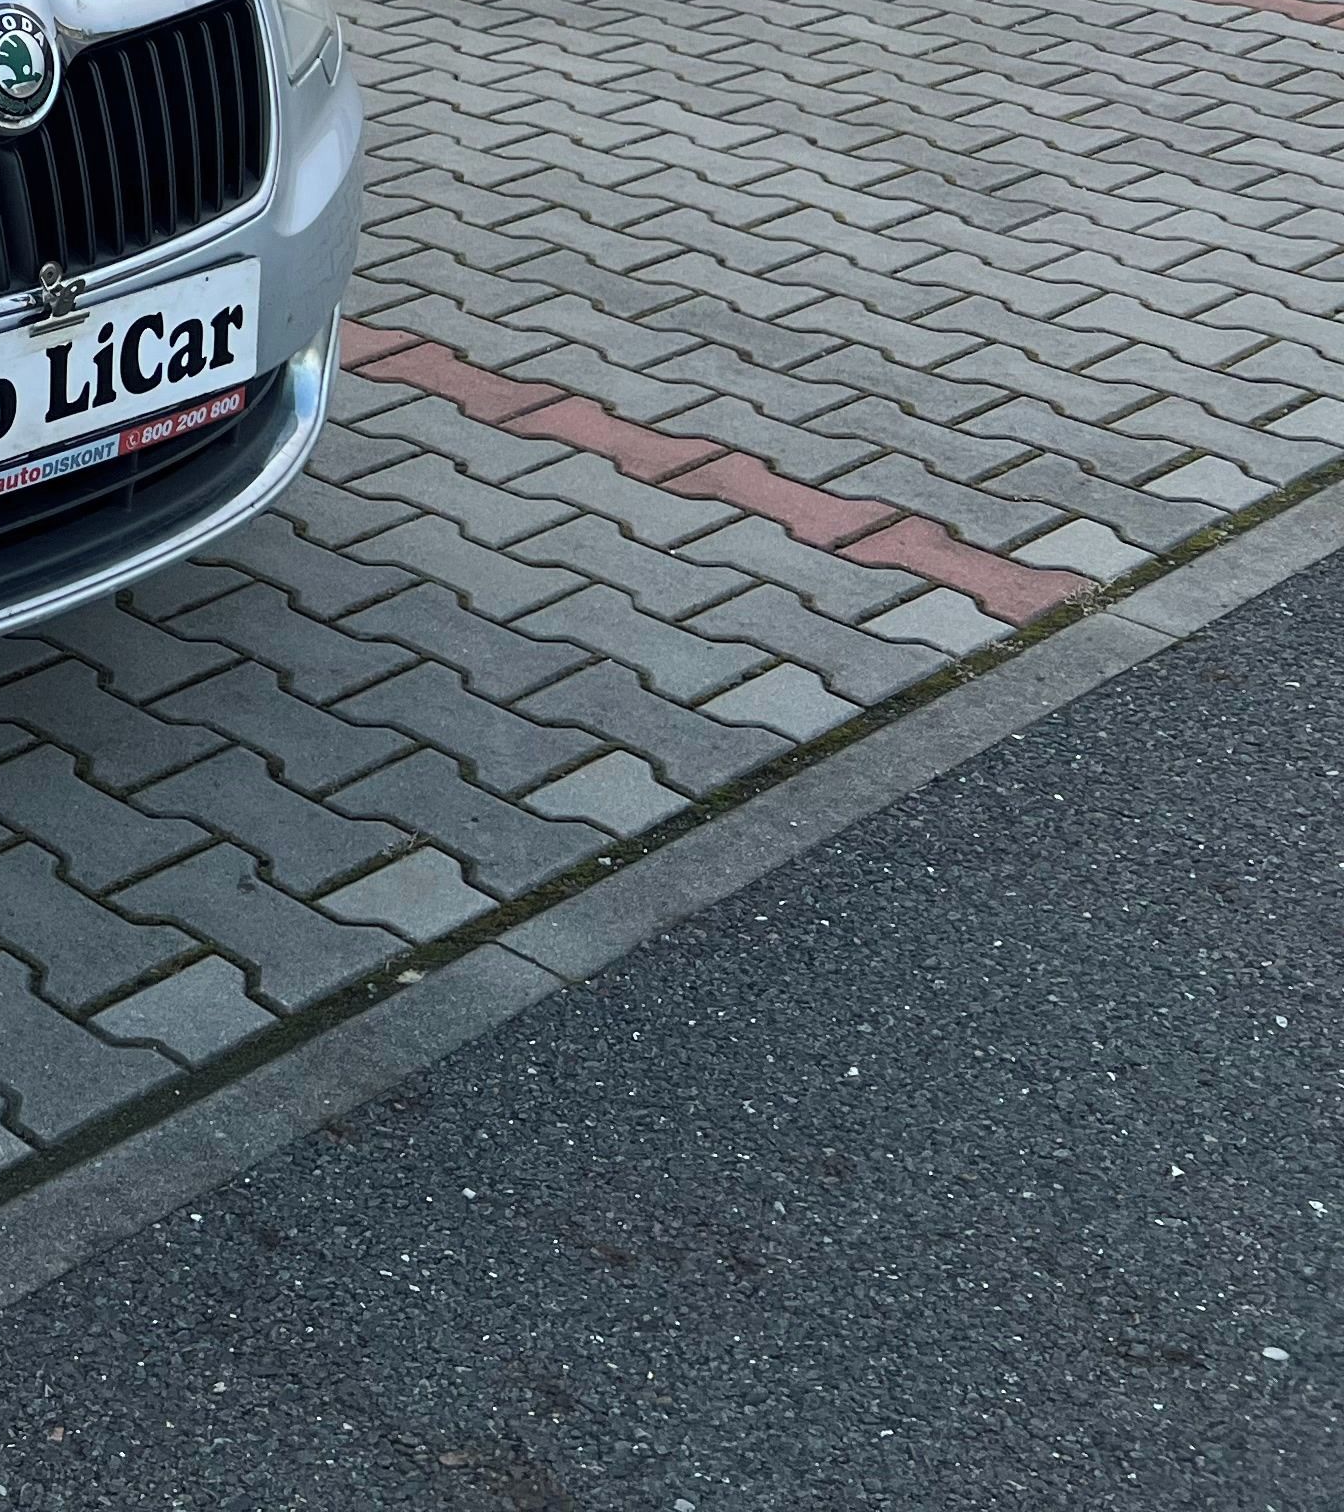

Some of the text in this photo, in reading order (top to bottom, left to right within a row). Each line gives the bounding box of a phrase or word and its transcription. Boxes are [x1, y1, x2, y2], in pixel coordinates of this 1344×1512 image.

[44, 304, 244, 424] LiCar
[140, 419, 174, 444] 800
[175, 406, 208, 432] 200
[209, 393, 241, 419] 800
